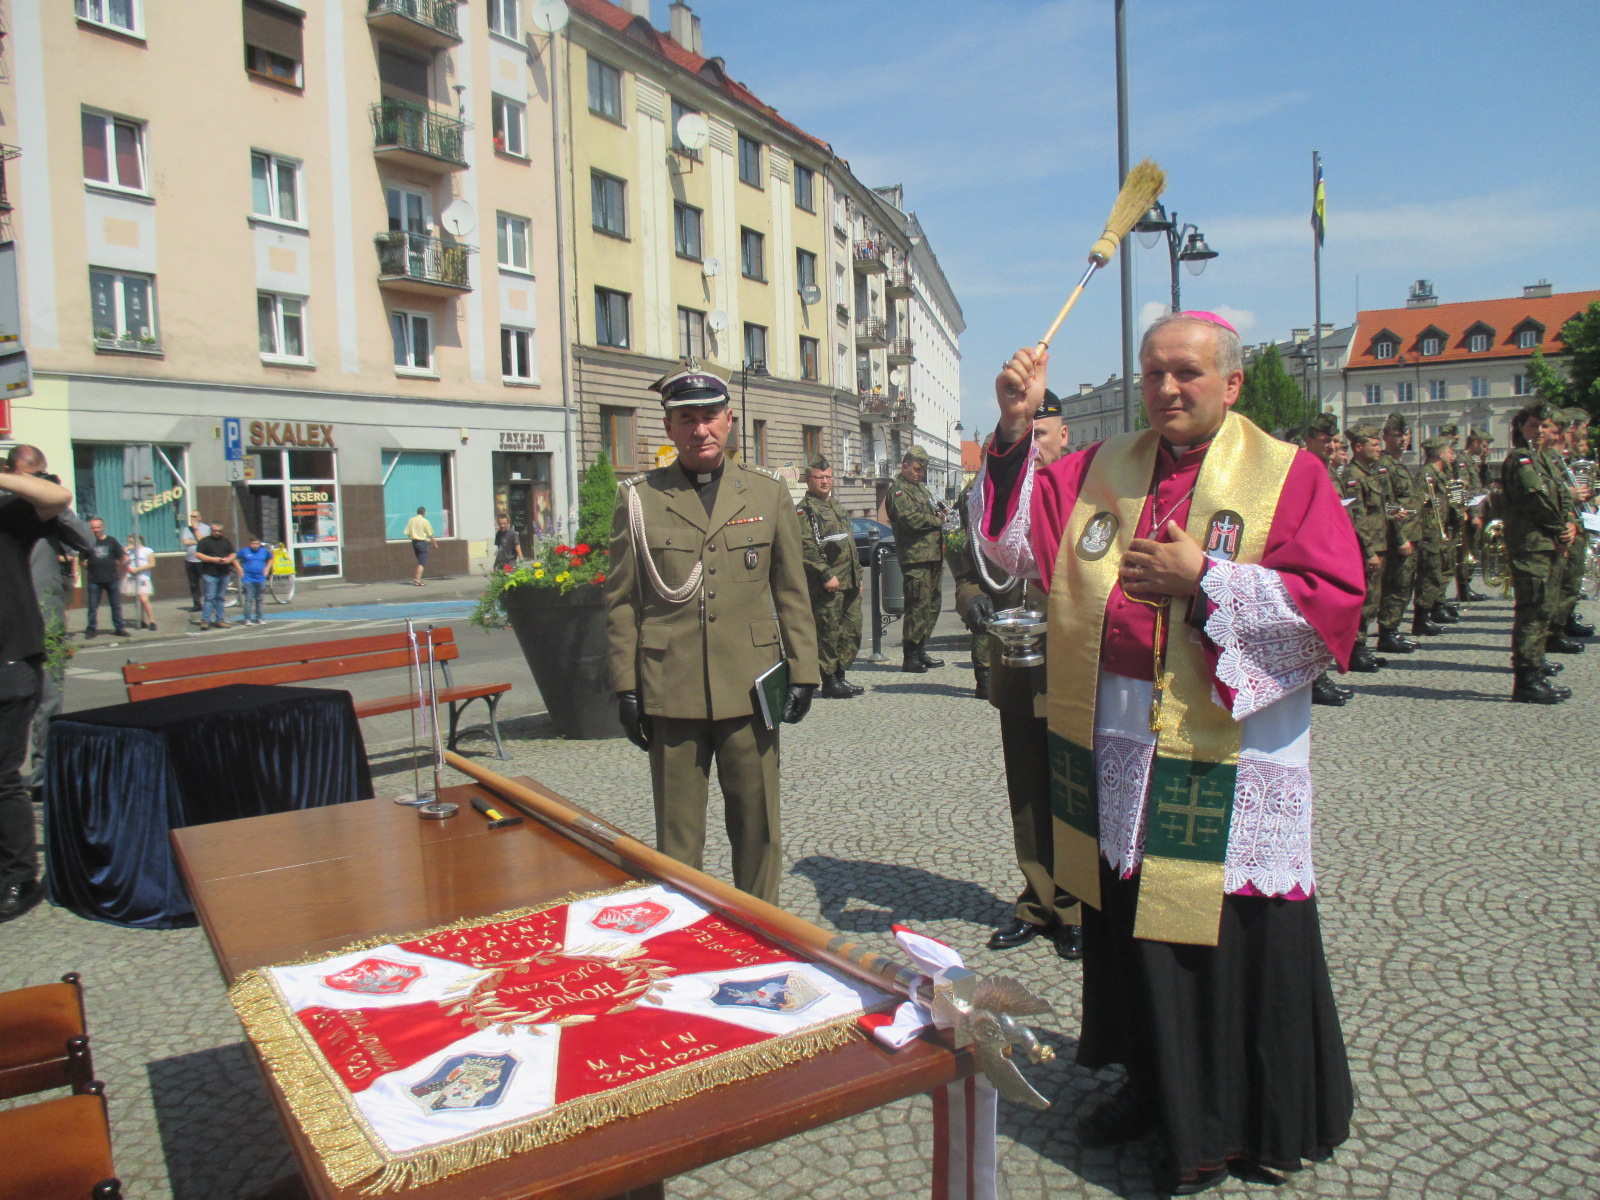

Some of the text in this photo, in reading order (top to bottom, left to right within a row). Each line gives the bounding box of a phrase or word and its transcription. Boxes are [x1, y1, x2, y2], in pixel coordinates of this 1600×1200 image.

[227, 421, 239, 448] P
[249, 421, 335, 448] SKALEX
[291, 492, 329, 502] KSERO
[527, 981, 618, 1009] HONOR
[587, 1031, 698, 1071] MALIN
